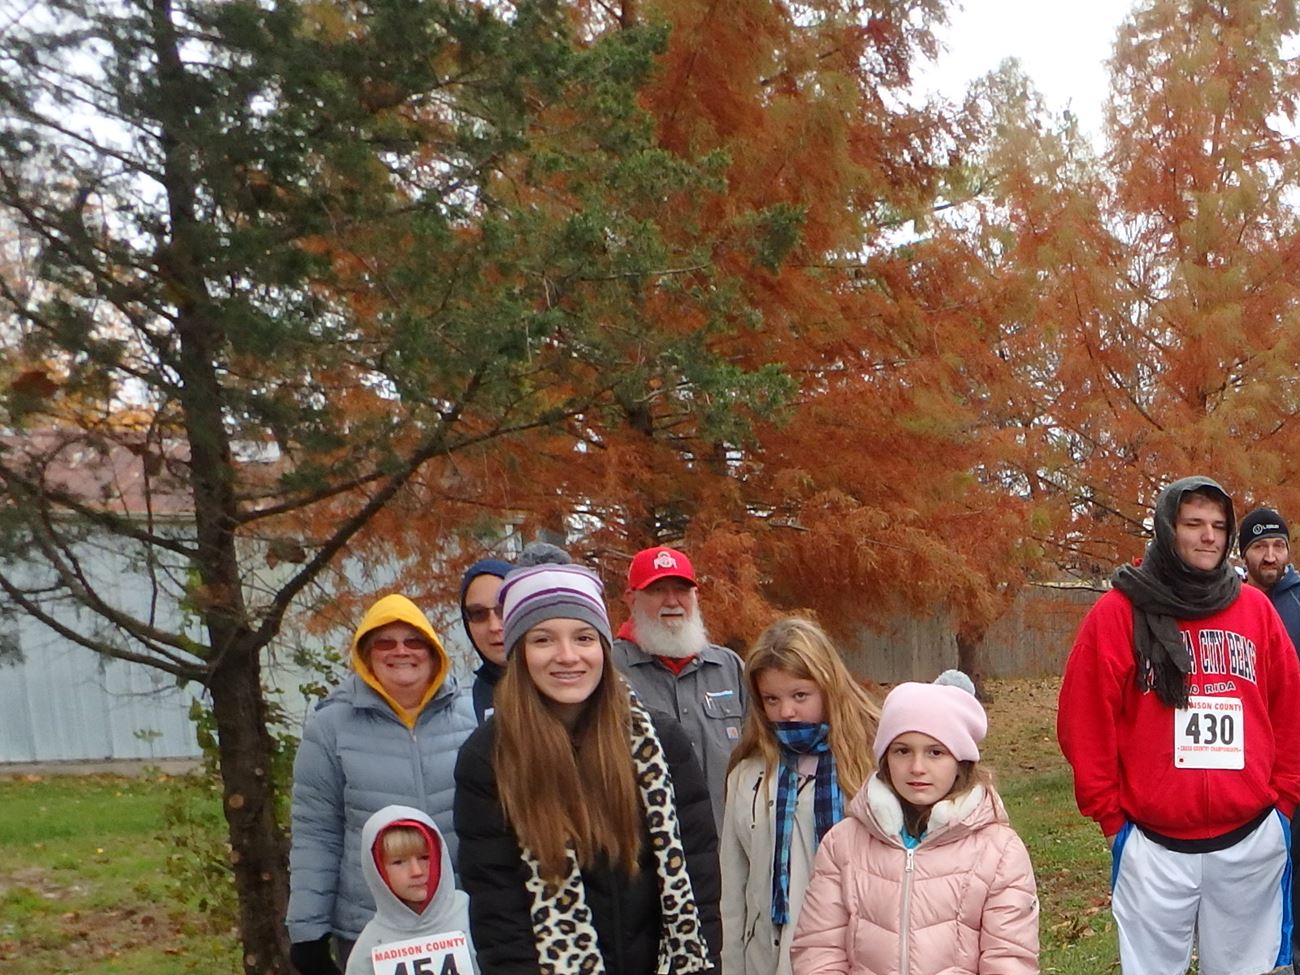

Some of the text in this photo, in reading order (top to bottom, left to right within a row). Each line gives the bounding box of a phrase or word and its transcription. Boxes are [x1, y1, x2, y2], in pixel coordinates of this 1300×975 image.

[1199, 629, 1226, 674] CITY
[1185, 713, 1234, 745] 430
[374, 937, 465, 962] MADISON COUNTY
